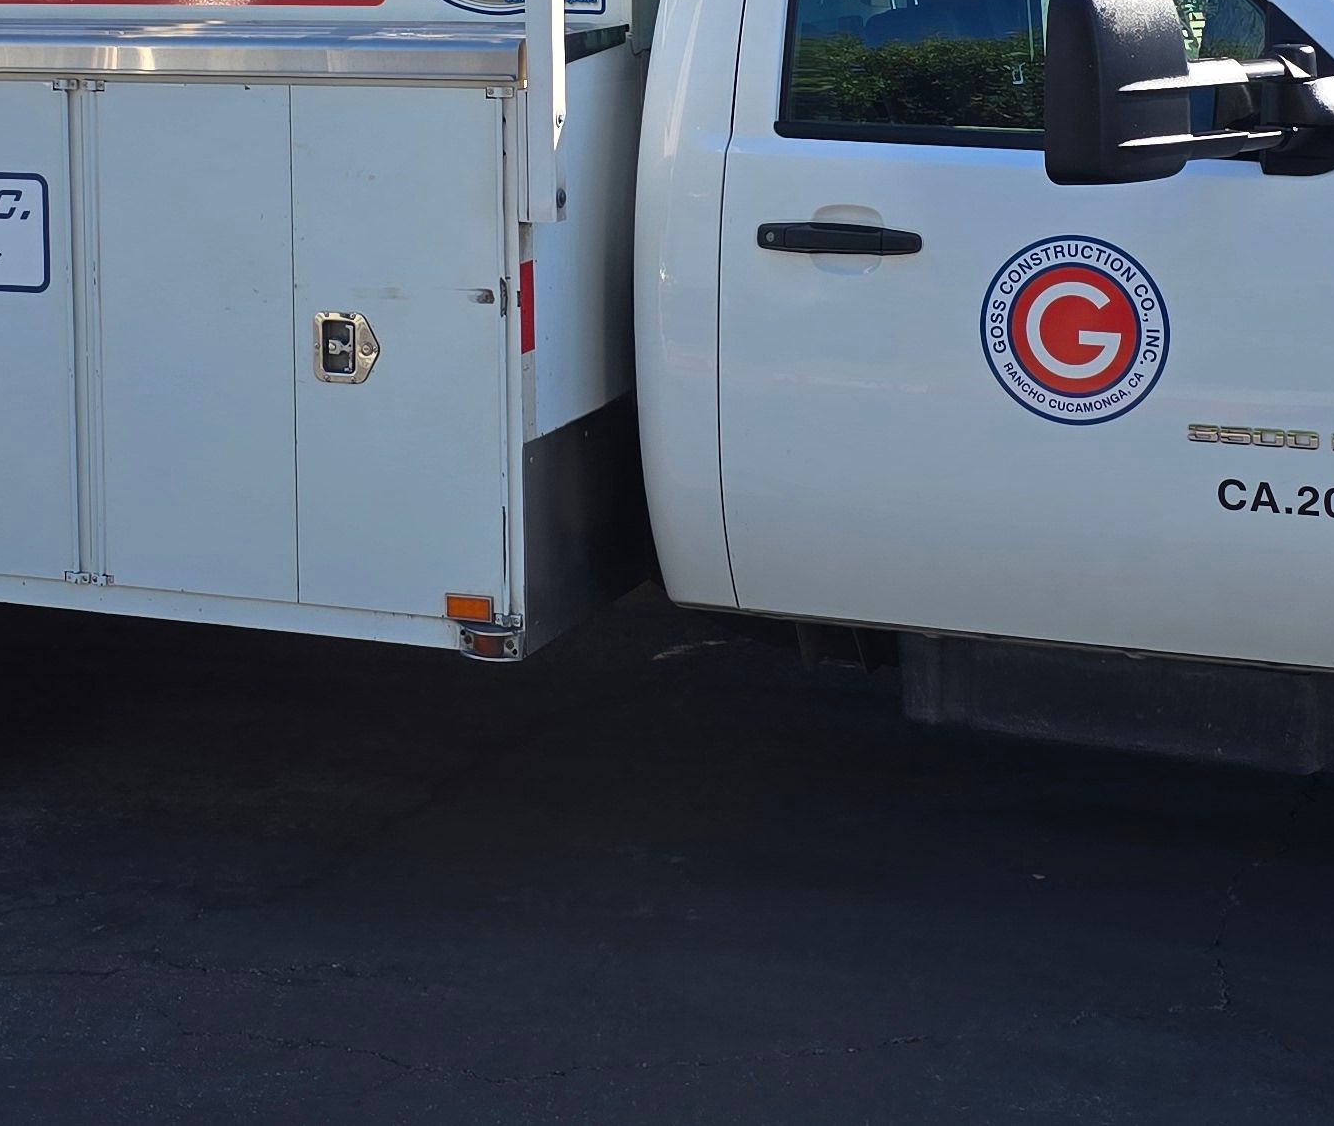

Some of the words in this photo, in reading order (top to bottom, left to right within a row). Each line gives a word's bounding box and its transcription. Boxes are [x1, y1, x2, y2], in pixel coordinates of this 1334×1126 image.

[999, 243, 1137, 295] CONSTRUCTION
[990, 299, 1007, 354] GOSS
[1133, 283, 1155, 323] CO.,
[1025, 281, 1122, 380] G
[1139, 328, 1160, 365] INC.
[1003, 361, 1046, 404] RANCHO
[1048, 388, 1132, 413] CUCAMONGA,
[1127, 372, 1145, 389] CA
